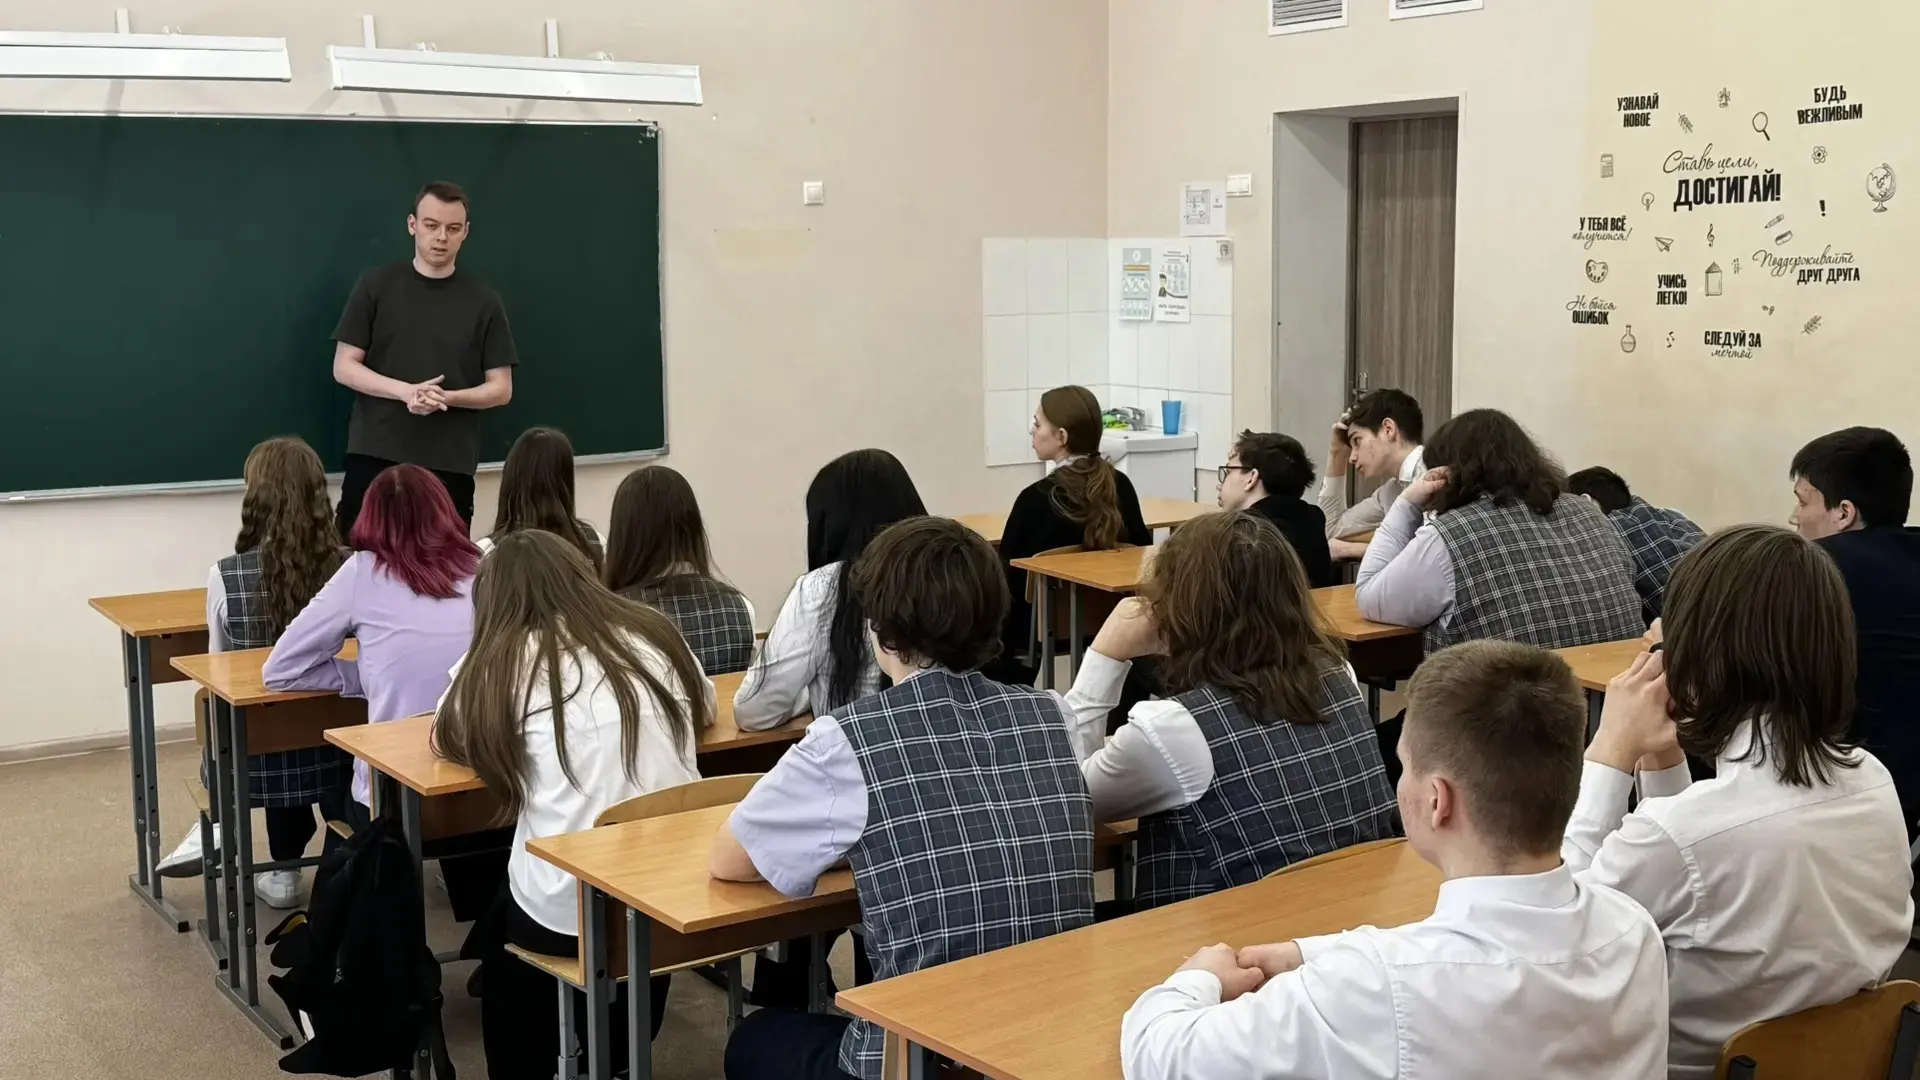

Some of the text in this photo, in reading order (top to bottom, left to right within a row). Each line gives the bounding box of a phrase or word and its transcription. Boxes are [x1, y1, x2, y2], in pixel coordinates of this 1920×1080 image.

[1617, 93, 1659, 111] УЗНАВАЙ
[1814, 85, 1847, 104] БУДЬ
[1623, 111, 1651, 127] НОВОЕ
[1797, 104, 1862, 125] ВЕЖЛИВЫМ
[1663, 143, 1758, 175] Ставь цели,
[1673, 169, 1781, 211] ДОСТИГАЙ!
[1579, 215, 1626, 231] У ТЕБЯ ВСЁ
[1657, 274, 1687, 289] УЧИСЬ
[1797, 267, 1860, 285] ДРУГ ДРУГА
[1566, 296, 1587, 311] Не
[1656, 291, 1687, 306] ЛЕГКО!
[1572, 310, 1609, 325] ОШИБОК
[1704, 329, 1761, 347] СЛЕДУЙ ЗА
